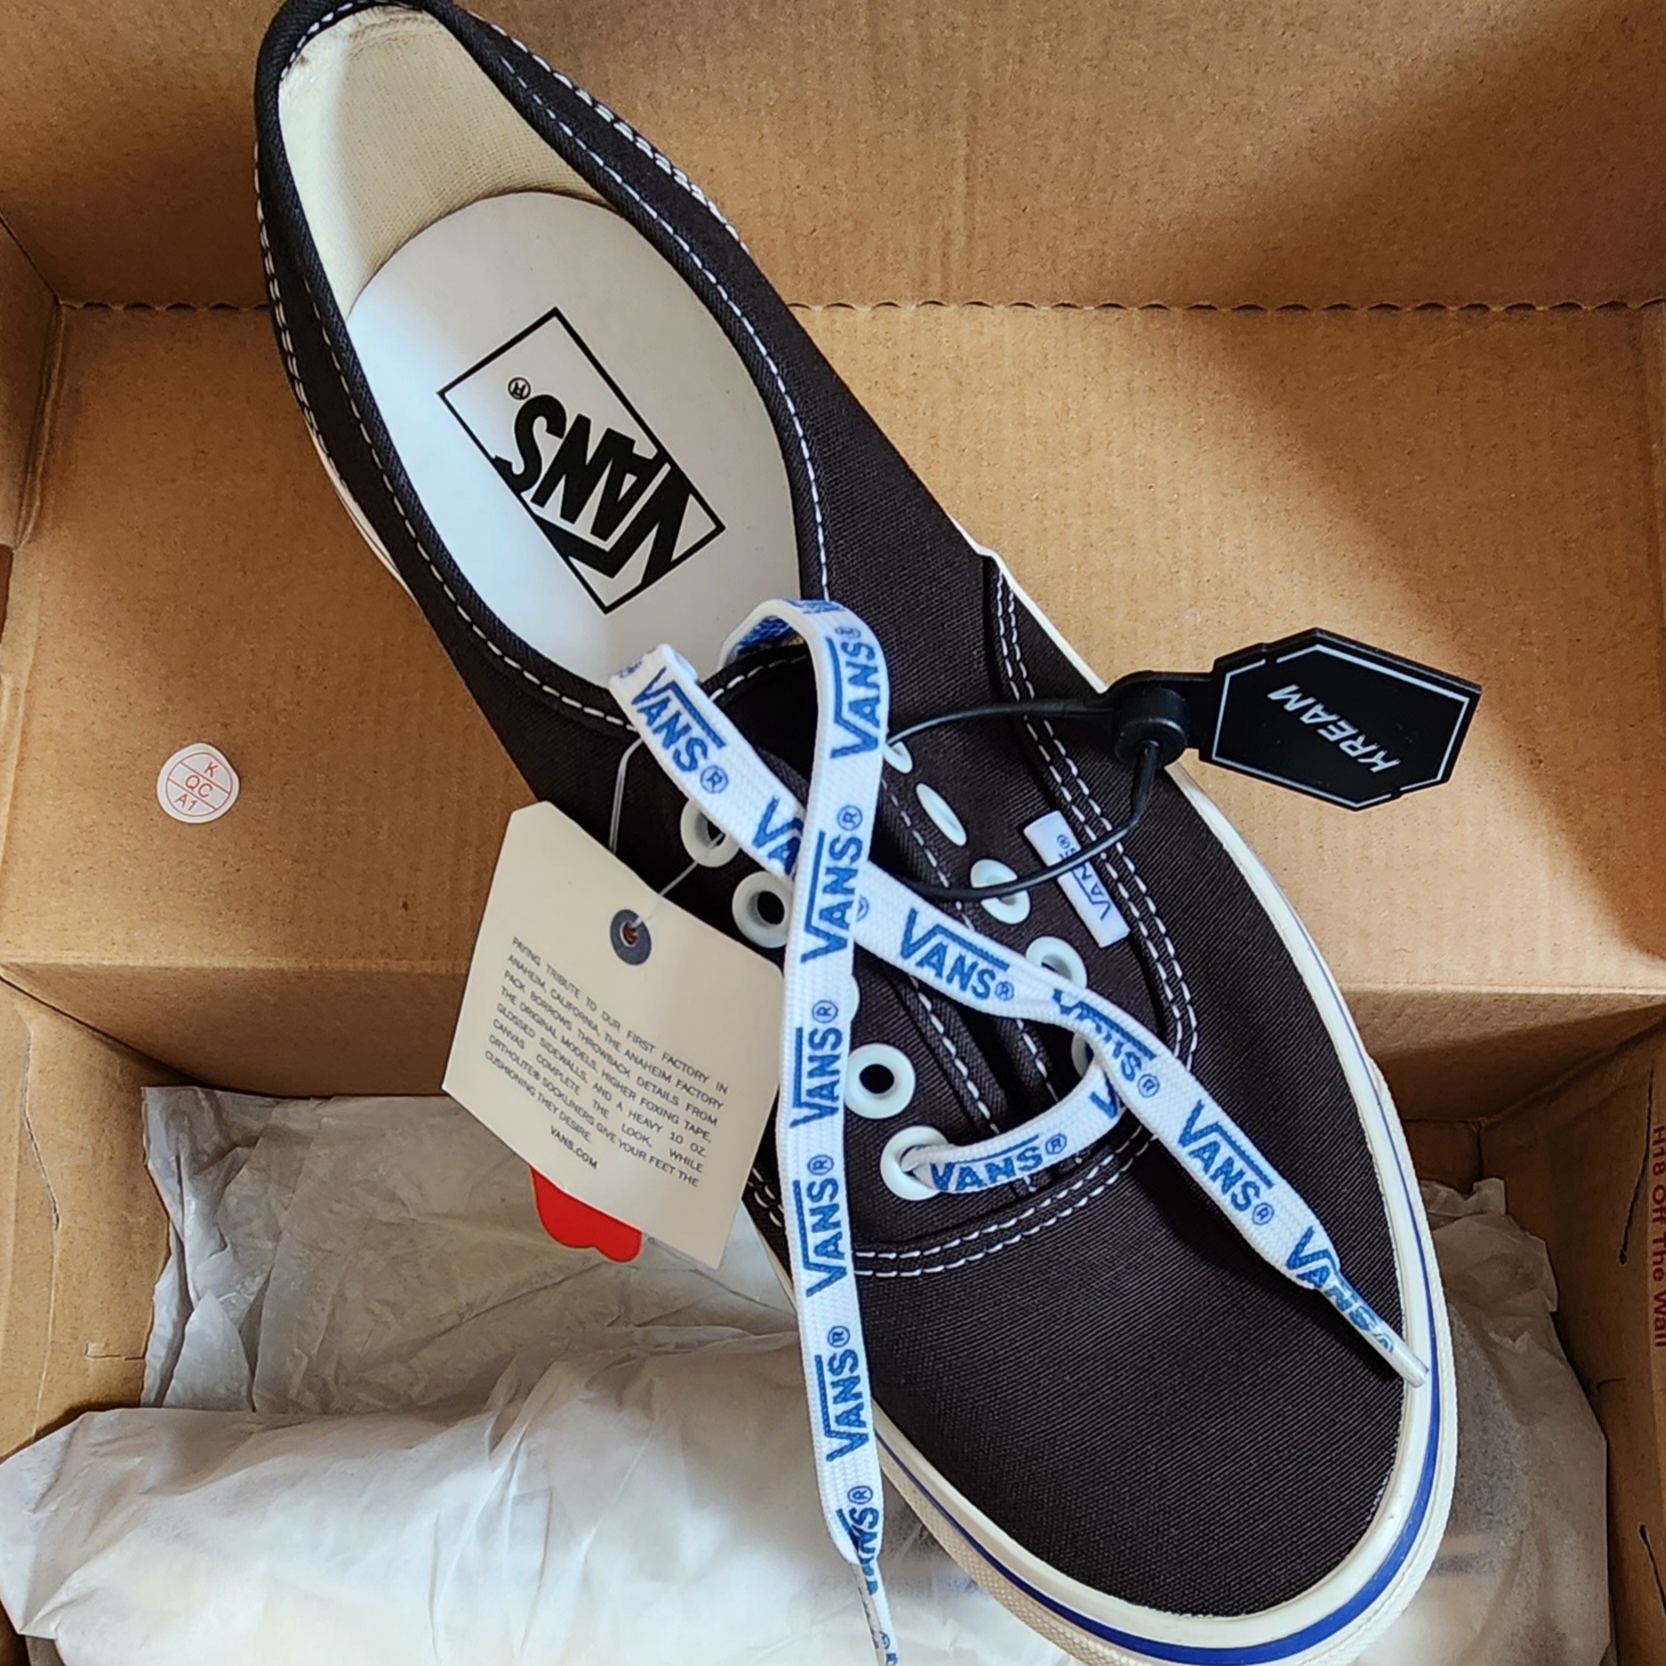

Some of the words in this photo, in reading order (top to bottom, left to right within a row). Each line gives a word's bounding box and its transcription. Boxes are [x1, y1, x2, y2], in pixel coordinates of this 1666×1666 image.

[204, 761, 218, 778] K
[1267, 684, 1401, 773] KREAM
[184, 774, 213, 798] QC
[504, 970, 525, 993] PACK
[530, 991, 572, 1031] BORROWS
[577, 1028, 631, 1078] THROWBACK
[636, 1075, 680, 1106] DETAILS
[685, 1103, 718, 1127] FROM
[512, 936, 541, 966] PAYING
[546, 963, 581, 999] TRIBUTE
[586, 996, 598, 1012] TO
[601, 1011, 621, 1031] OUR
[626, 1030, 656, 1053] FIRST
[661, 1052, 710, 1084] FACTORY
[715, 1081, 728, 1095] IN
[485, 1050, 536, 1097] CUSHIONING
[537, 1092, 559, 1115] THEY
[493, 1019, 525, 1050] CANVAS
[536, 1054, 581, 1096] COMPLETE
[593, 1099, 610, 1119] THE
[621, 1123, 653, 1148] LOOK,
[669, 1148, 704, 1173] WHILE
[497, 1003, 536, 1039] GLOSSED
[593, 1082, 613, 1102] AND
[616, 1101, 623, 1111] A
[628, 1110, 664, 1133] HEAVY
[669, 1131, 684, 1145] 10
[501, 985, 518, 1006] THE
[519, 1002, 557, 1040] ORIGINAL
[601, 1069, 637, 1101] HIGHER
[640, 1097, 680, 1125] FOXING
[684, 1120, 711, 1144] TAPE,
[604, 1031, 621, 1052] THE
[624, 1049, 672, 1083] ANAHEIM
[675, 1079, 724, 1110] FACTORY
[542, 1077, 594, 1126] SOCKLINERS
[596, 1122, 617, 1144] GIVE
[619, 1139, 647, 1161] YOUR
[649, 1156, 676, 1175] FEET
[678, 1170, 700, 1188] THE
[551, 1125, 598, 1169] VANS.COM
[1652, 1231, 1666, 1282] The
[1653, 1289, 1666, 1347] Wall
